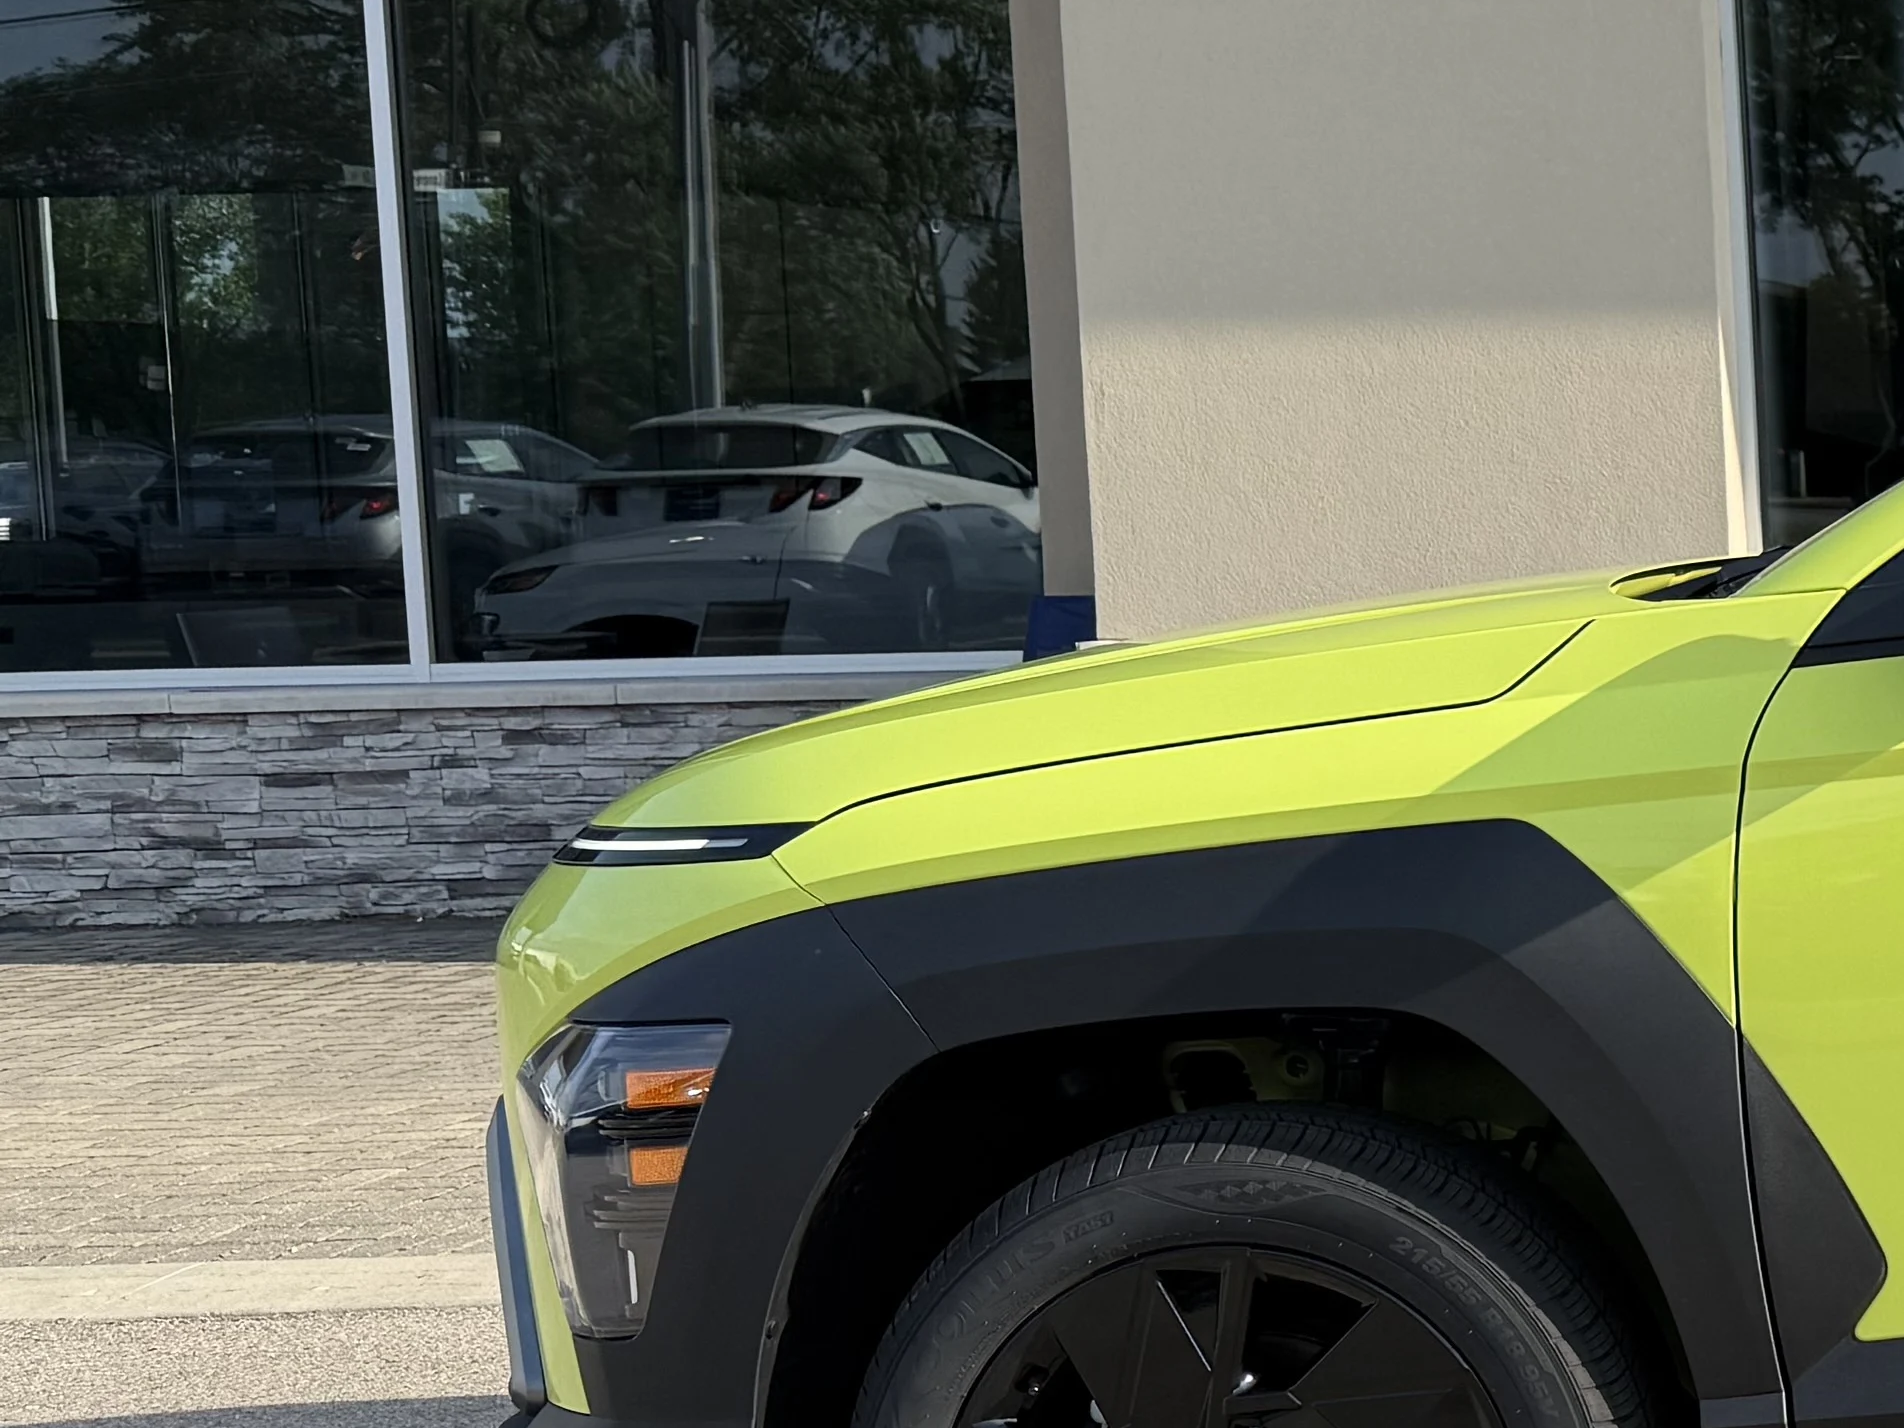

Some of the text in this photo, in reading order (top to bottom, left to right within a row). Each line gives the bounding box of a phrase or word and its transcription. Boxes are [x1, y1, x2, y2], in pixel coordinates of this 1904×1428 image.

[1388, 1235, 1561, 1420] 215/55 R18 95V
